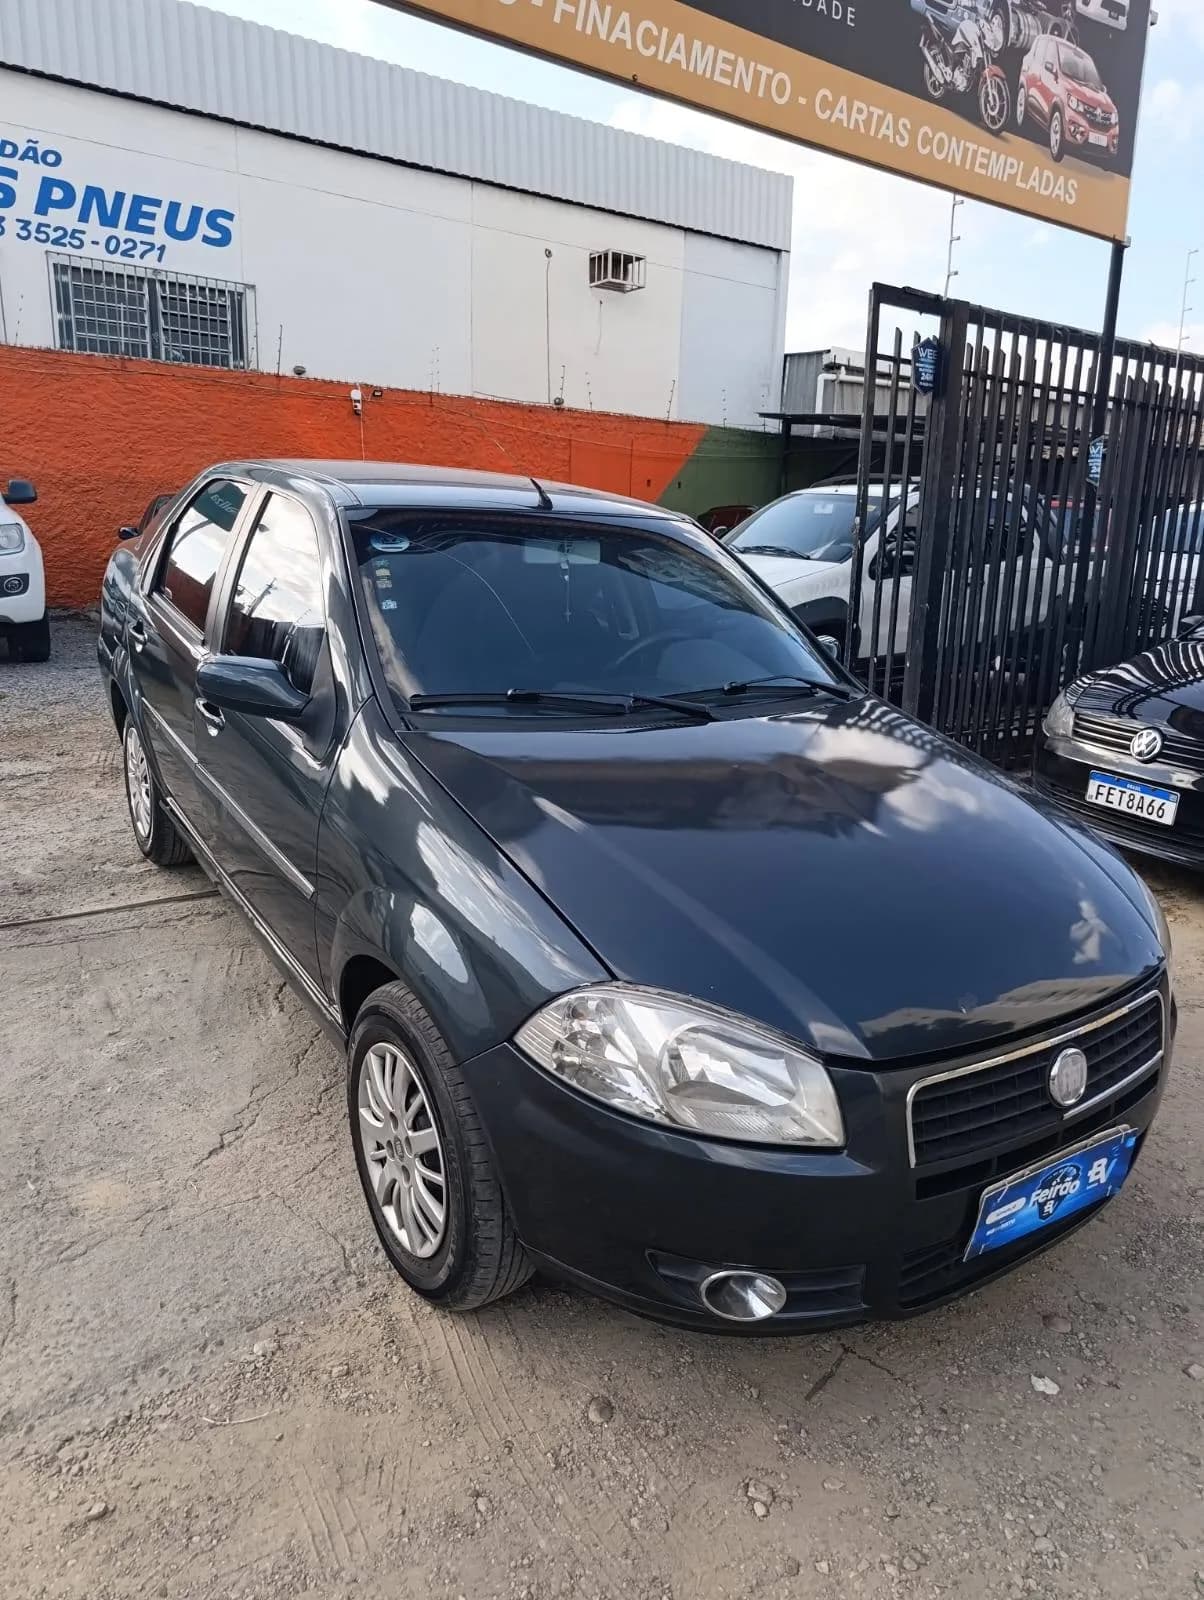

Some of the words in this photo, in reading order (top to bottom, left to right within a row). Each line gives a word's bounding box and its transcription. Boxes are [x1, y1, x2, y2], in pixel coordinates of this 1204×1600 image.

[553, 0, 792, 104] FINACIAMENTO
[814, 87, 910, 148] CARTAS
[916, 126, 1078, 205] CONTEMPLADAS
[33, 175, 235, 248] PNEUS
[1095, 784, 1166, 819] FET8A66
[1028, 1176, 1081, 1208] Feirão
